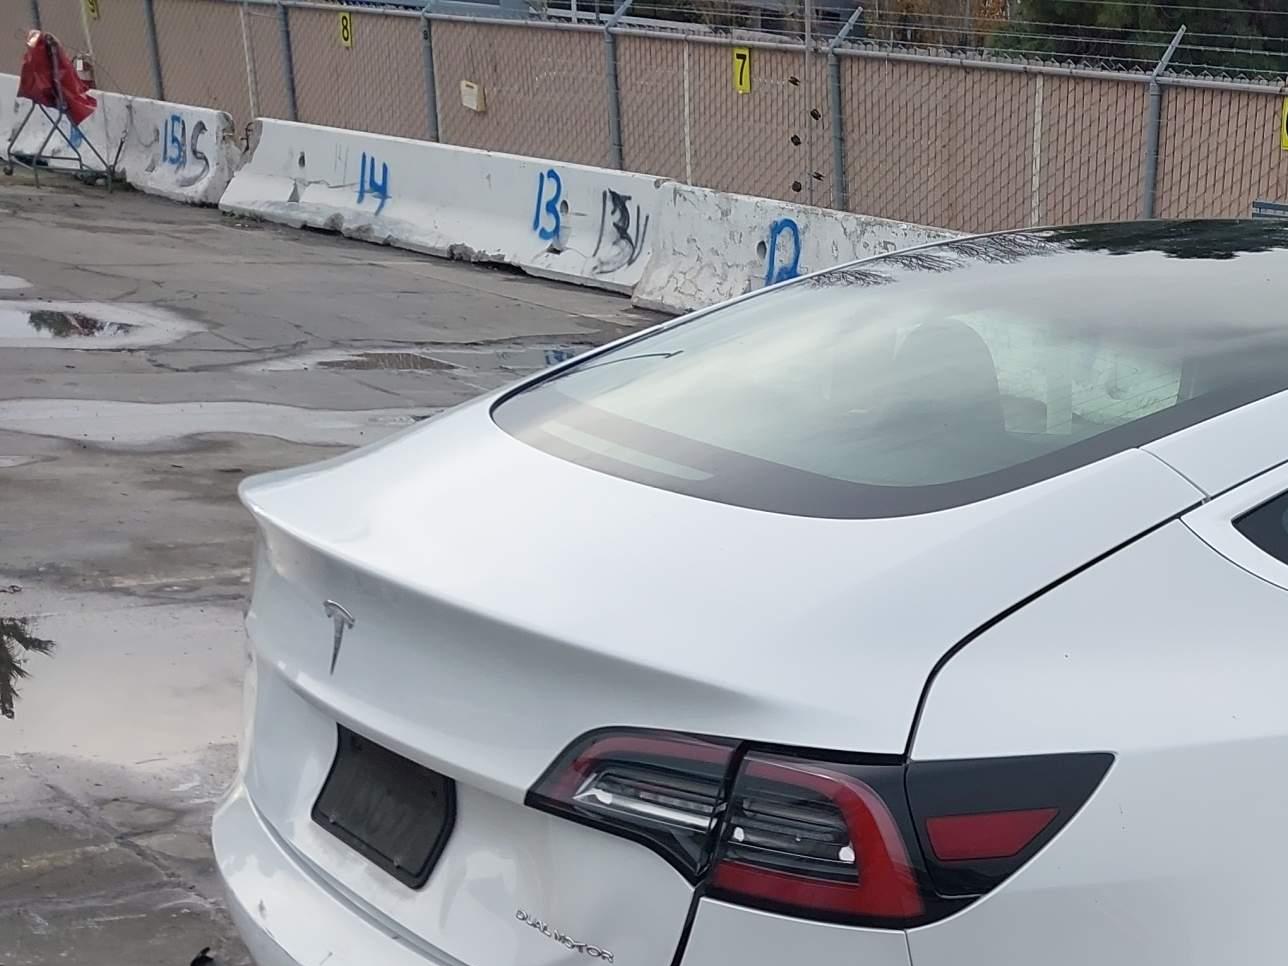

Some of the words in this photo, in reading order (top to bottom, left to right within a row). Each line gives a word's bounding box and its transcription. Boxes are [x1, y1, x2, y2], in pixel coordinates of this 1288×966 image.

[341, 15, 350, 42] 8
[735, 53, 747, 86] 7
[357, 152, 388, 217] 14
[533, 169, 562, 241] 13
[516, 910, 552, 938] DUAL
[553, 928, 615, 964] MOTOR
